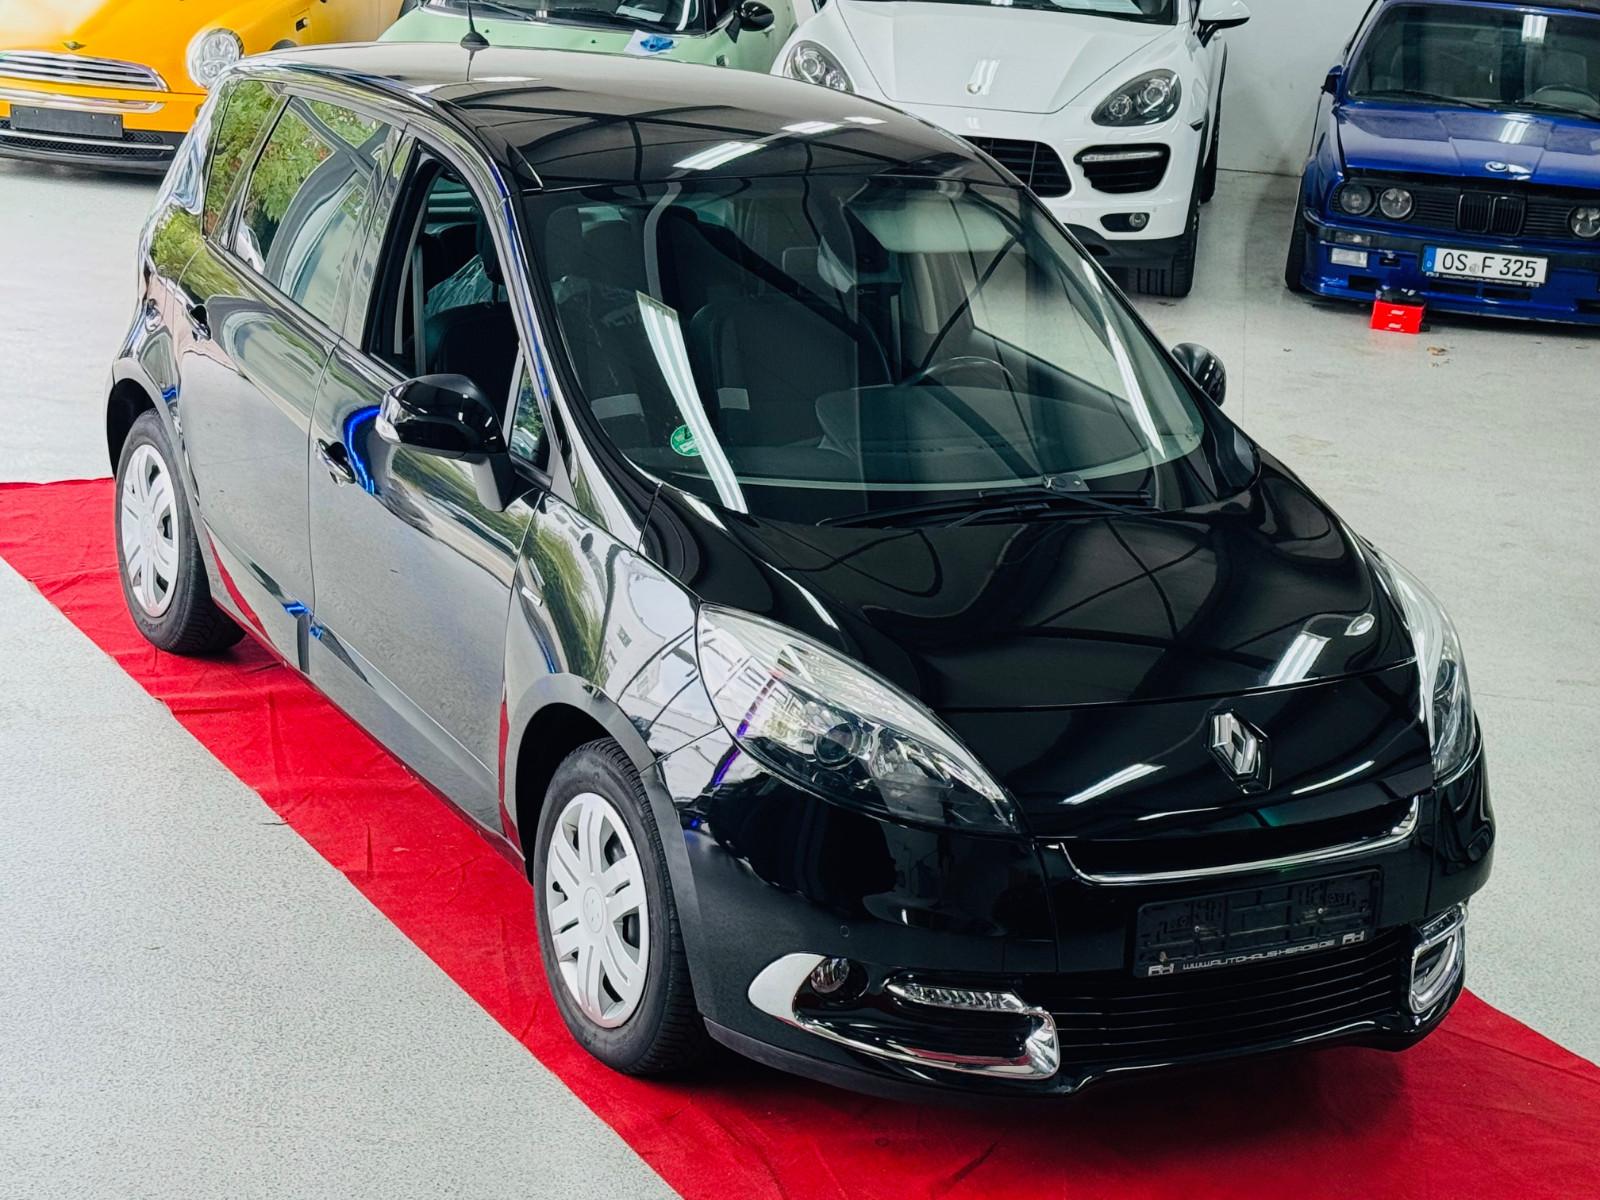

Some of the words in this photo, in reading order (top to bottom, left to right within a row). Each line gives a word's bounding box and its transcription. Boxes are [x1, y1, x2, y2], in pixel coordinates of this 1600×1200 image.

[1442, 252, 1468, 271] OS
[1481, 256, 1495, 274] F
[1499, 257, 1538, 278] 325
